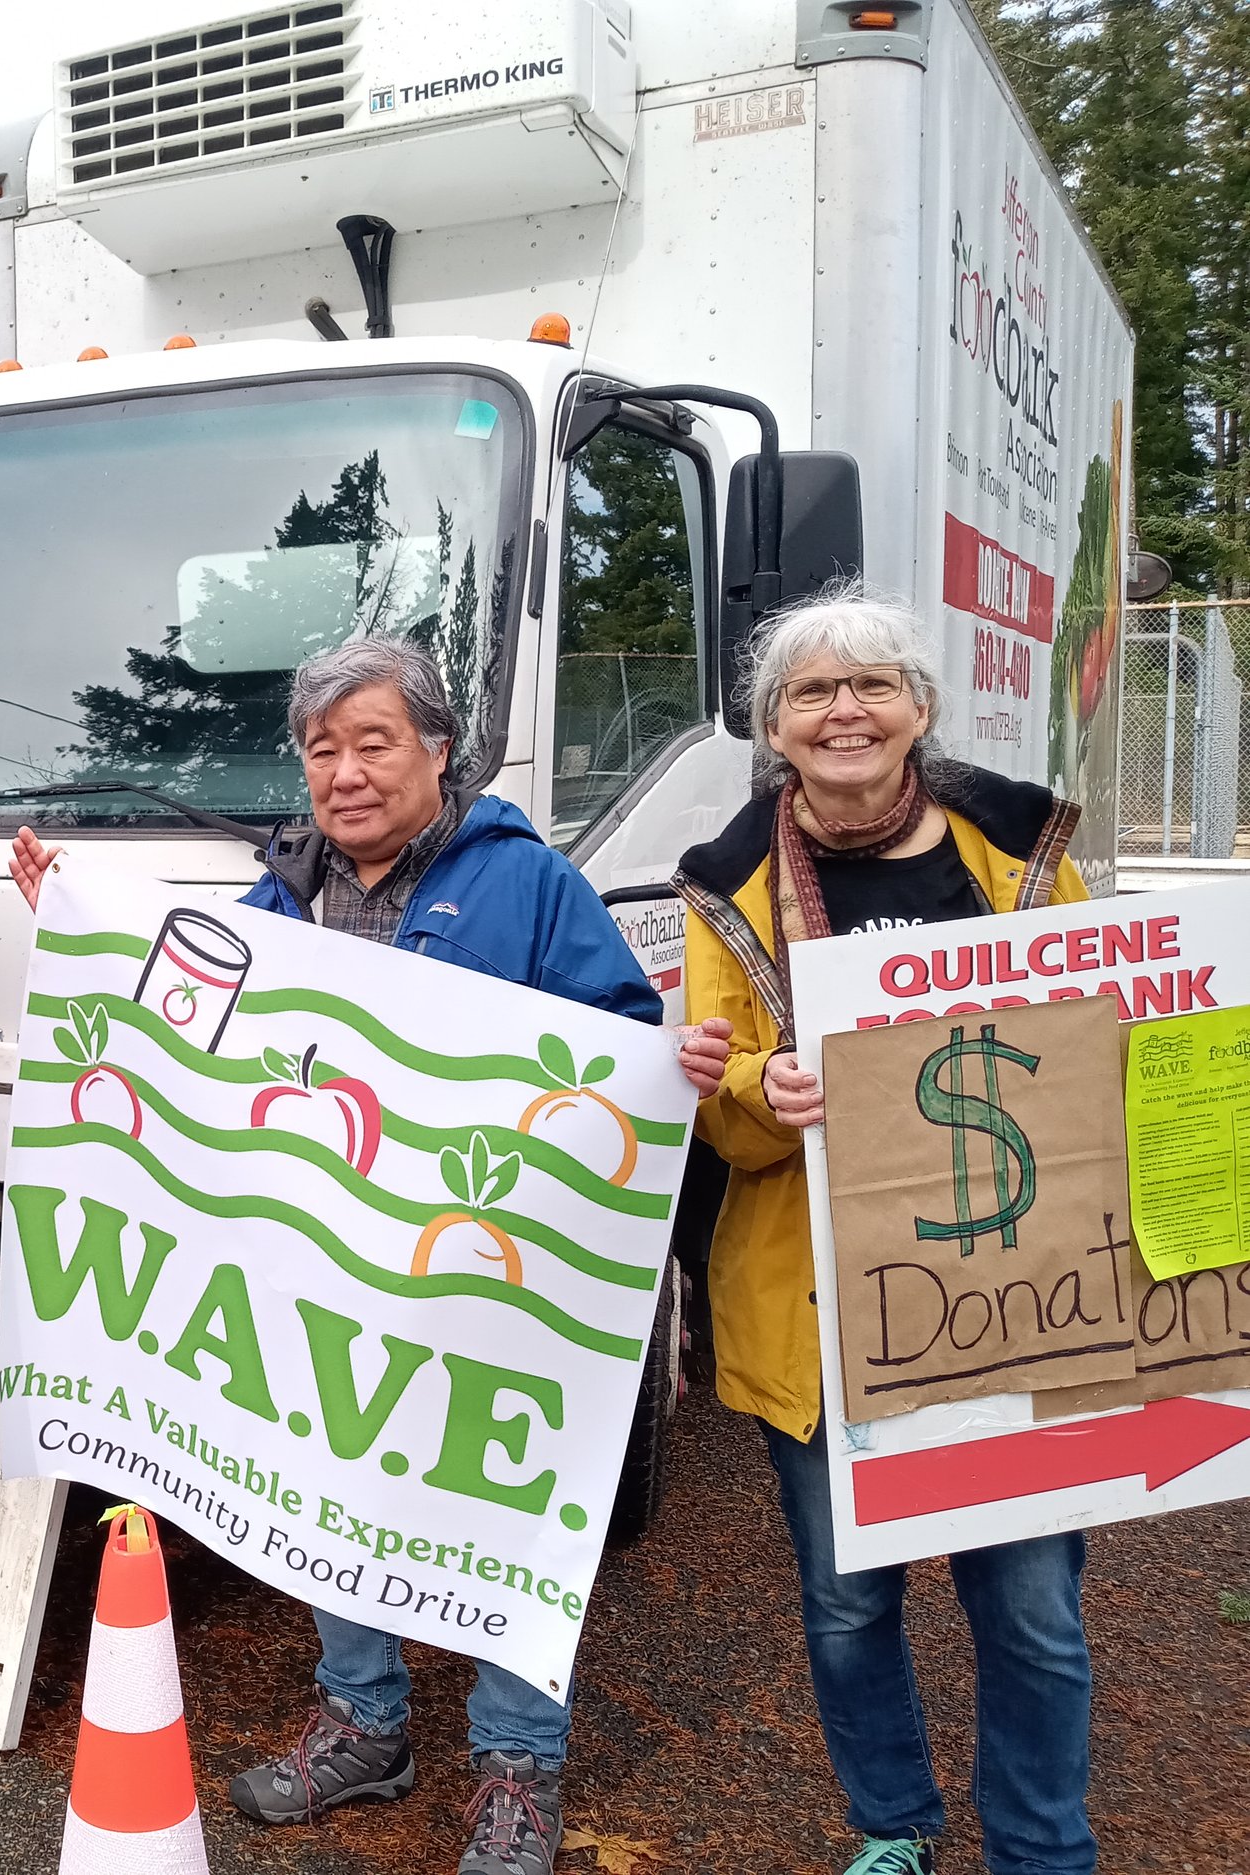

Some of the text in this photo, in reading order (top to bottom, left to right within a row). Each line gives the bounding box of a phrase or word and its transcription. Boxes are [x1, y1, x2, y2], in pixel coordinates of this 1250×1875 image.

[400, 57, 564, 103] THERMO KING
[694, 87, 804, 132] HEISER
[1002, 161, 1039, 270] Jfferson
[1006, 418, 1058, 506] Asociaion
[879, 914, 1181, 998] QUILCENE
[1139, 1059, 1193, 1081] W.A.V.E.
[1208, 1039, 1250, 1061] foodb
[1141, 1096, 1162, 1105] Catch
[1176, 1090, 1193, 1098] wave
[1194, 1087, 1208, 1095] and
[1176, 1098, 1207, 1109] delicious
[7, 1184, 589, 1531] W.A.V.E.
[38, 1418, 508, 1637] Community Food Drive
[103, 1386, 132, 1421] A
[144, 1398, 303, 1516] Valuable
[315, 1496, 583, 1621] Experience
